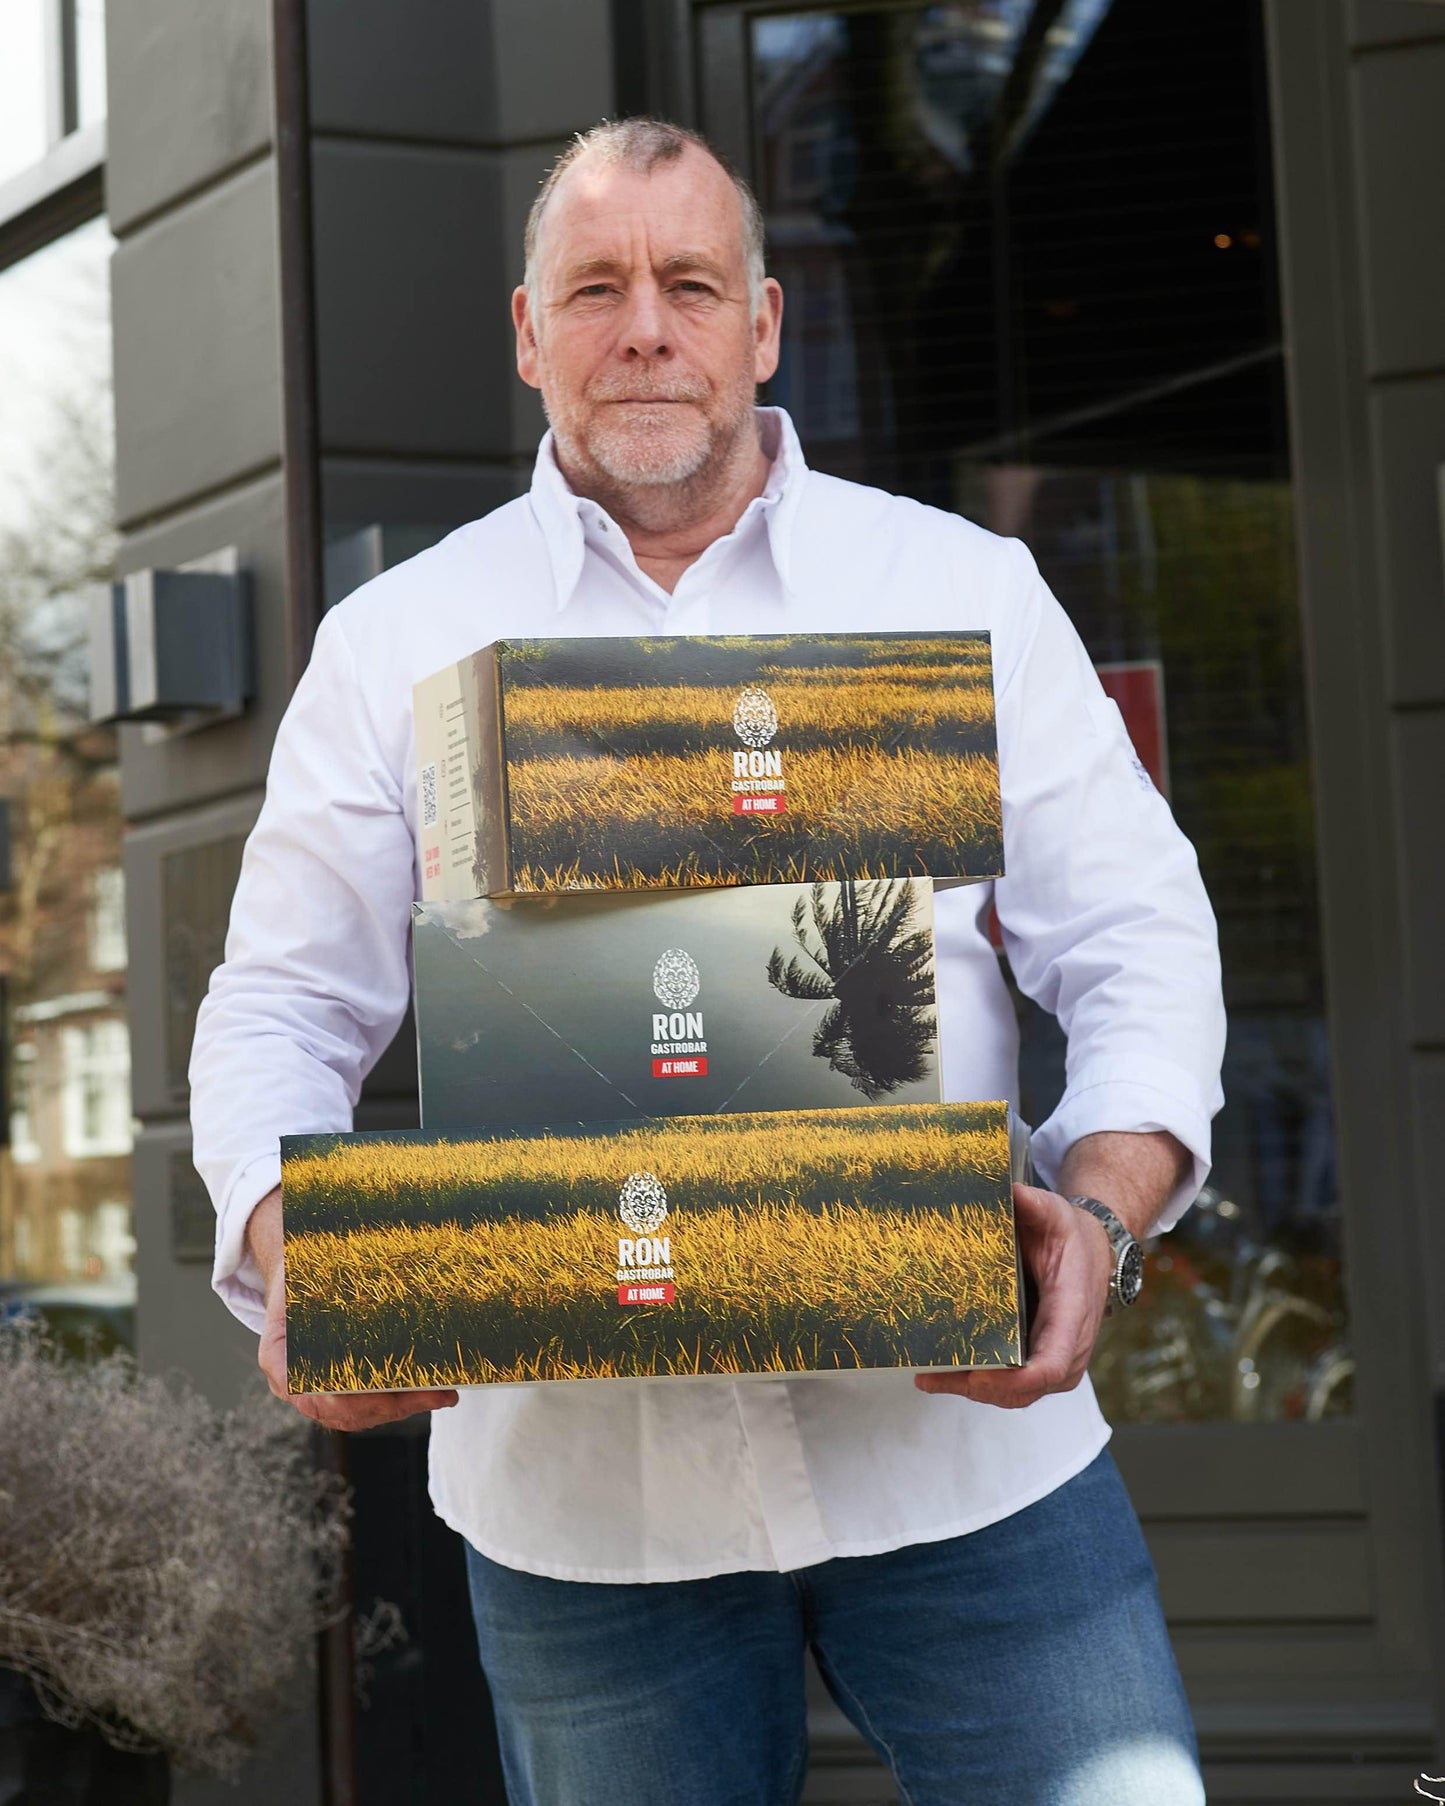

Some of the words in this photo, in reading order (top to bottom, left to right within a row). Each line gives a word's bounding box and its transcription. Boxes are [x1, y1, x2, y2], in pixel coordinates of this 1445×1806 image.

[733, 750, 782, 778] RON
[731, 780, 785, 792] GASTROBAR
[742, 799, 752, 811] AT
[753, 799, 777, 810] HOME
[652, 1012, 703, 1041] RON
[650, 1042, 707, 1055] GASTROBAR
[661, 1062, 672, 1074] AT
[673, 1061, 699, 1073] HOME
[618, 1237, 671, 1267] RON
[616, 1268, 674, 1281] GASTROBAR
[627, 1289, 638, 1301] AT
[640, 1288, 665, 1300] HOME
